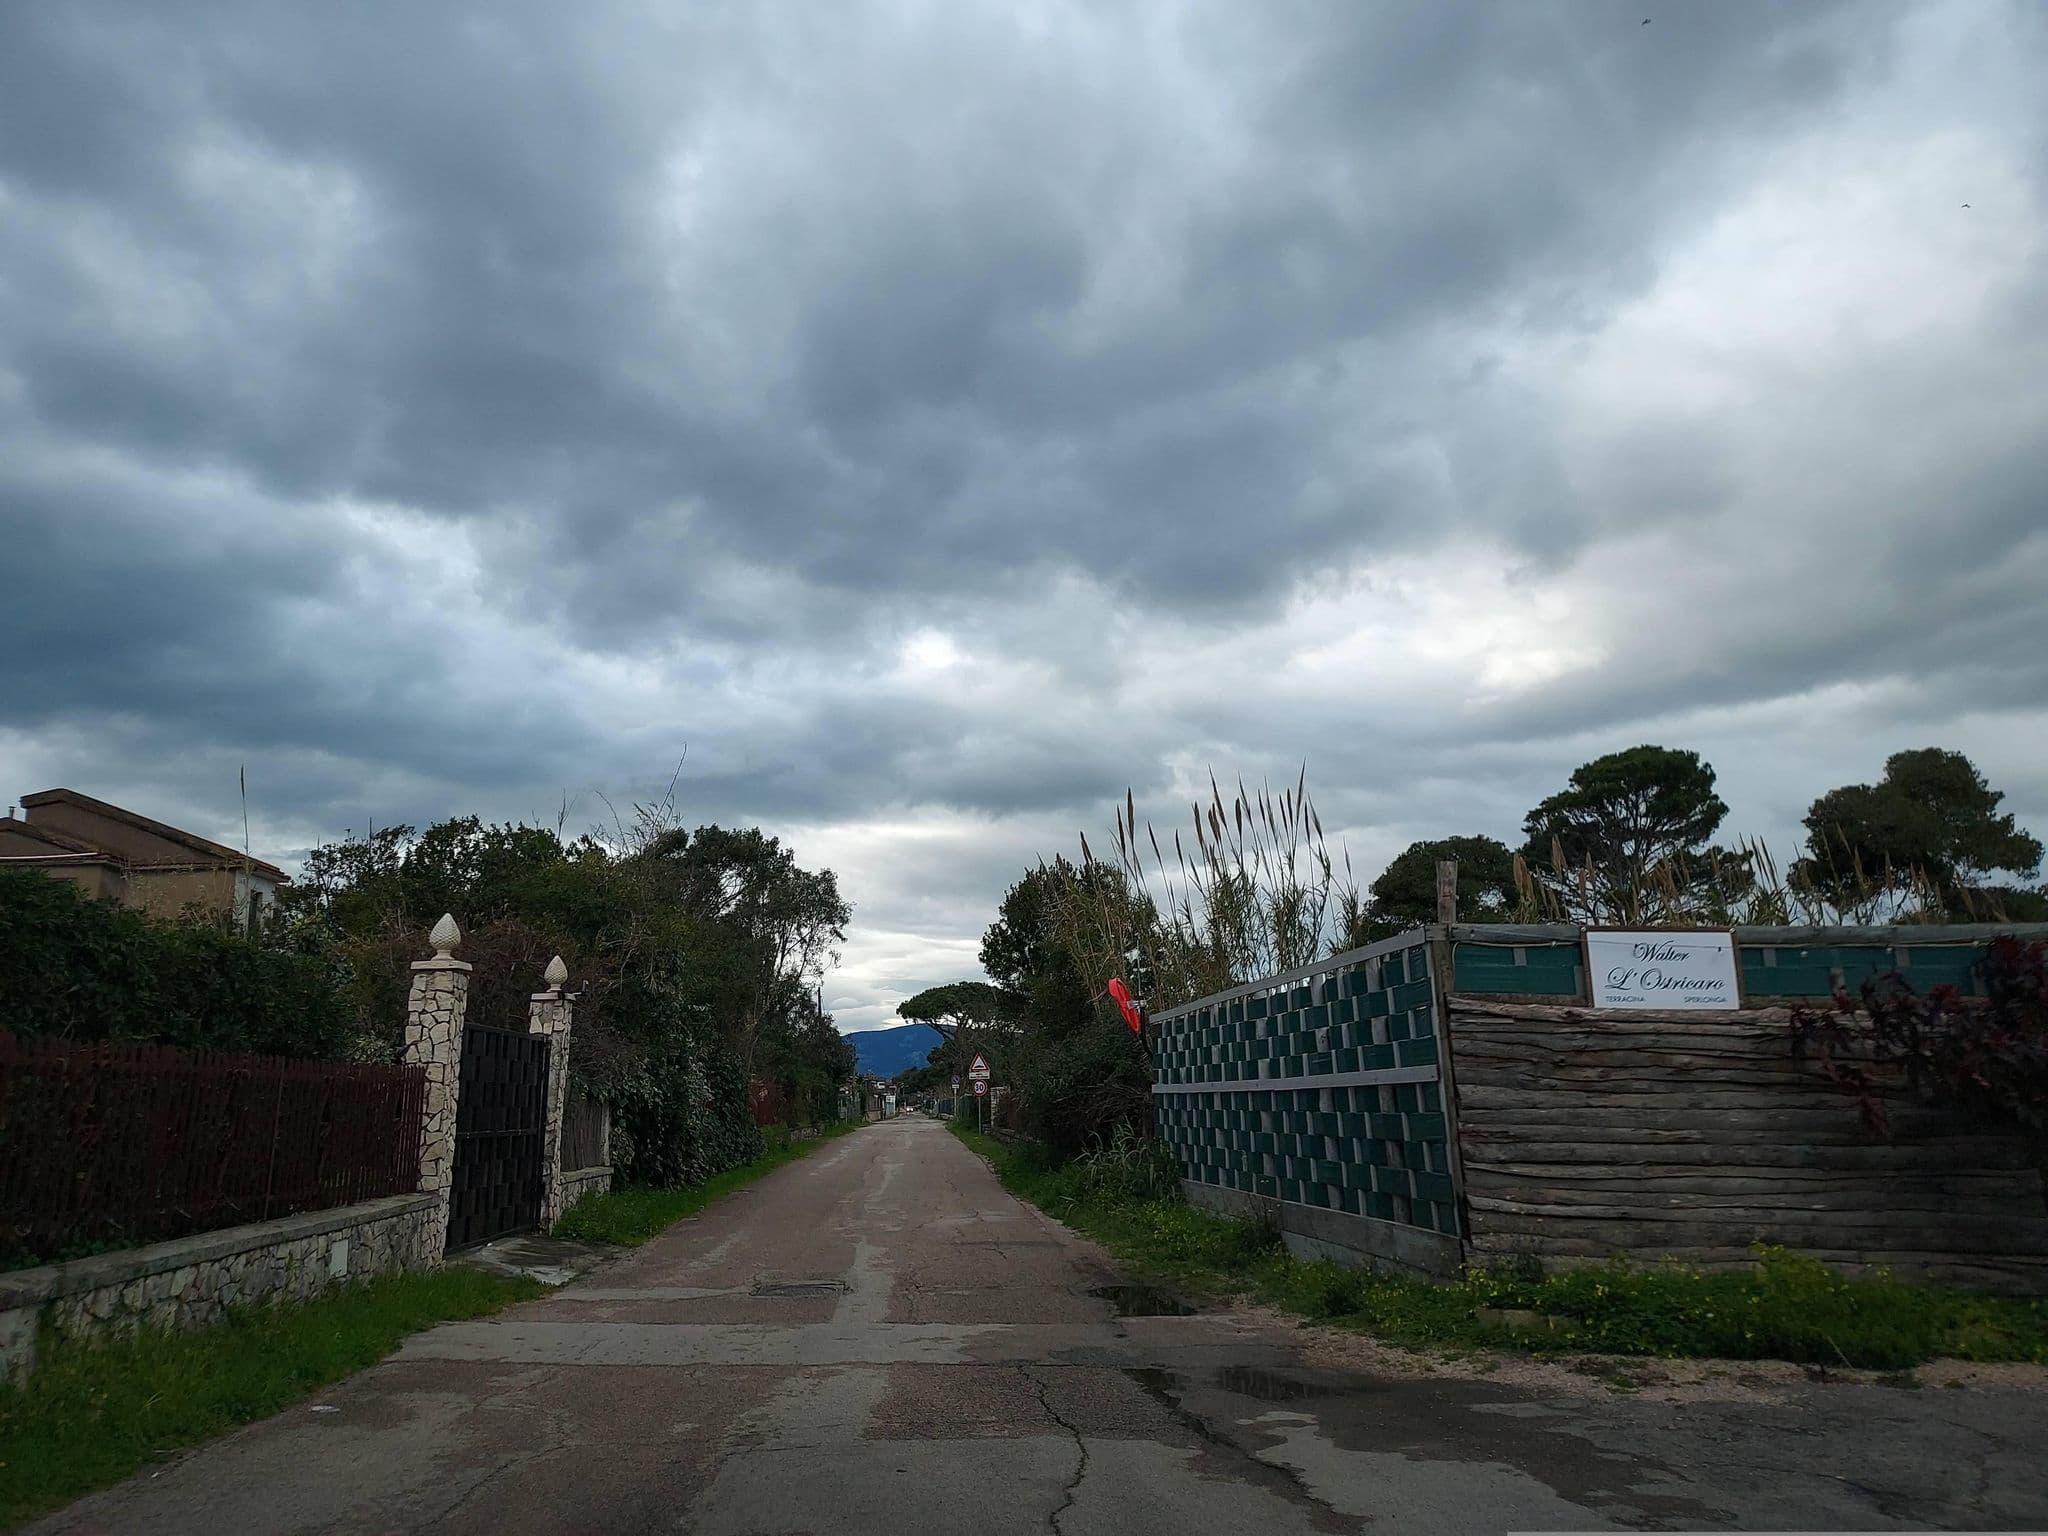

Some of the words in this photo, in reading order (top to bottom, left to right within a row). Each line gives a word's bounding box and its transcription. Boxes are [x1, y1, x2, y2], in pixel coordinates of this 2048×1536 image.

[1633, 940, 1689, 962] Walter
[1640, 968, 1725, 990] Ostricaro
[975, 1083, 984, 1091] 30
